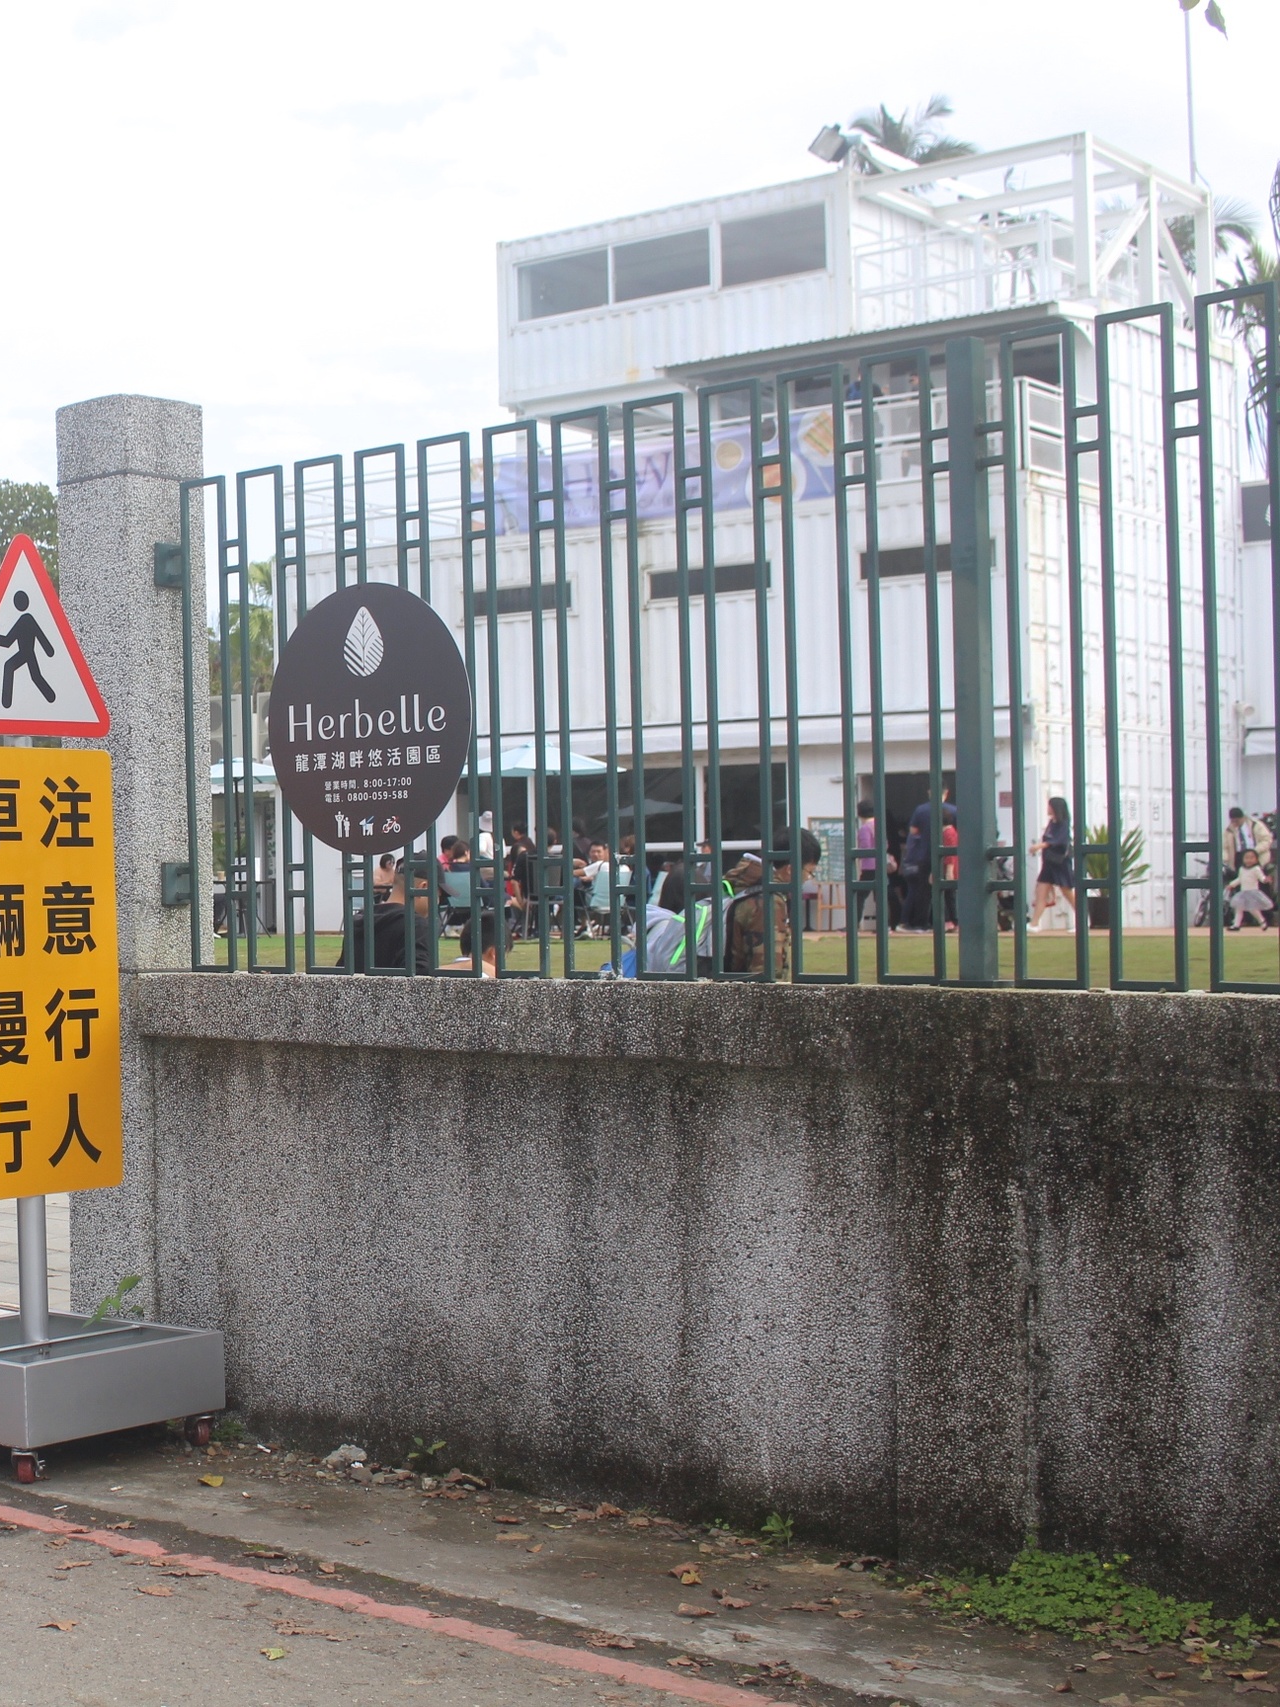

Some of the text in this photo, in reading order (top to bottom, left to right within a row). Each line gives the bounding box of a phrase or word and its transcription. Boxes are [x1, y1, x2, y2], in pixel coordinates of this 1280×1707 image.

[288, 693, 447, 743] Herbelle
[295, 744, 441, 773] 龍潭湖畔悠活園區
[347, 790, 409, 802] 0800-059-588
[363, 776, 412, 788] 8:00-17:00
[38, 775, 103, 1168] 注意行人
